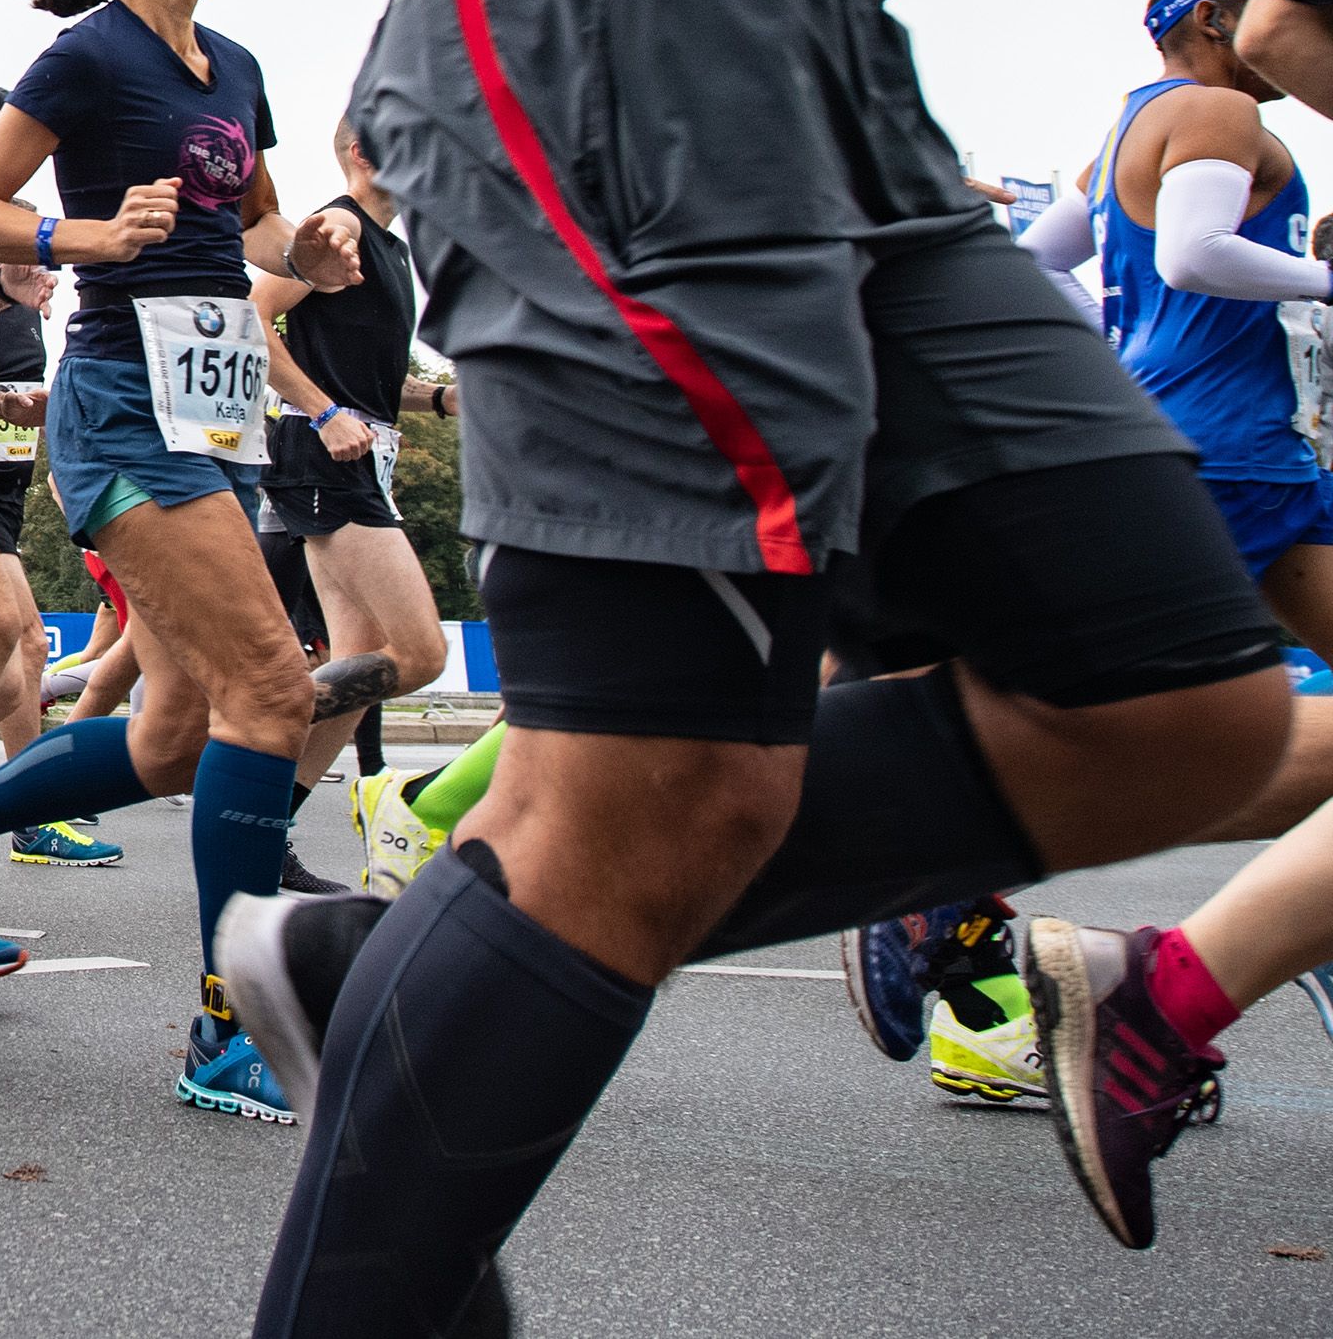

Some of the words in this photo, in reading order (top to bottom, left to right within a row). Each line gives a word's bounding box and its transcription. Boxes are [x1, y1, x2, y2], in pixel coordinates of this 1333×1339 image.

[188, 144, 211, 159] we
[214, 156, 237, 173] run
[178, 347, 263, 403] 15166
[215, 401, 246, 424] Katja
[14, 433, 27, 442] Rico
[9, 446, 25, 455] Giti
